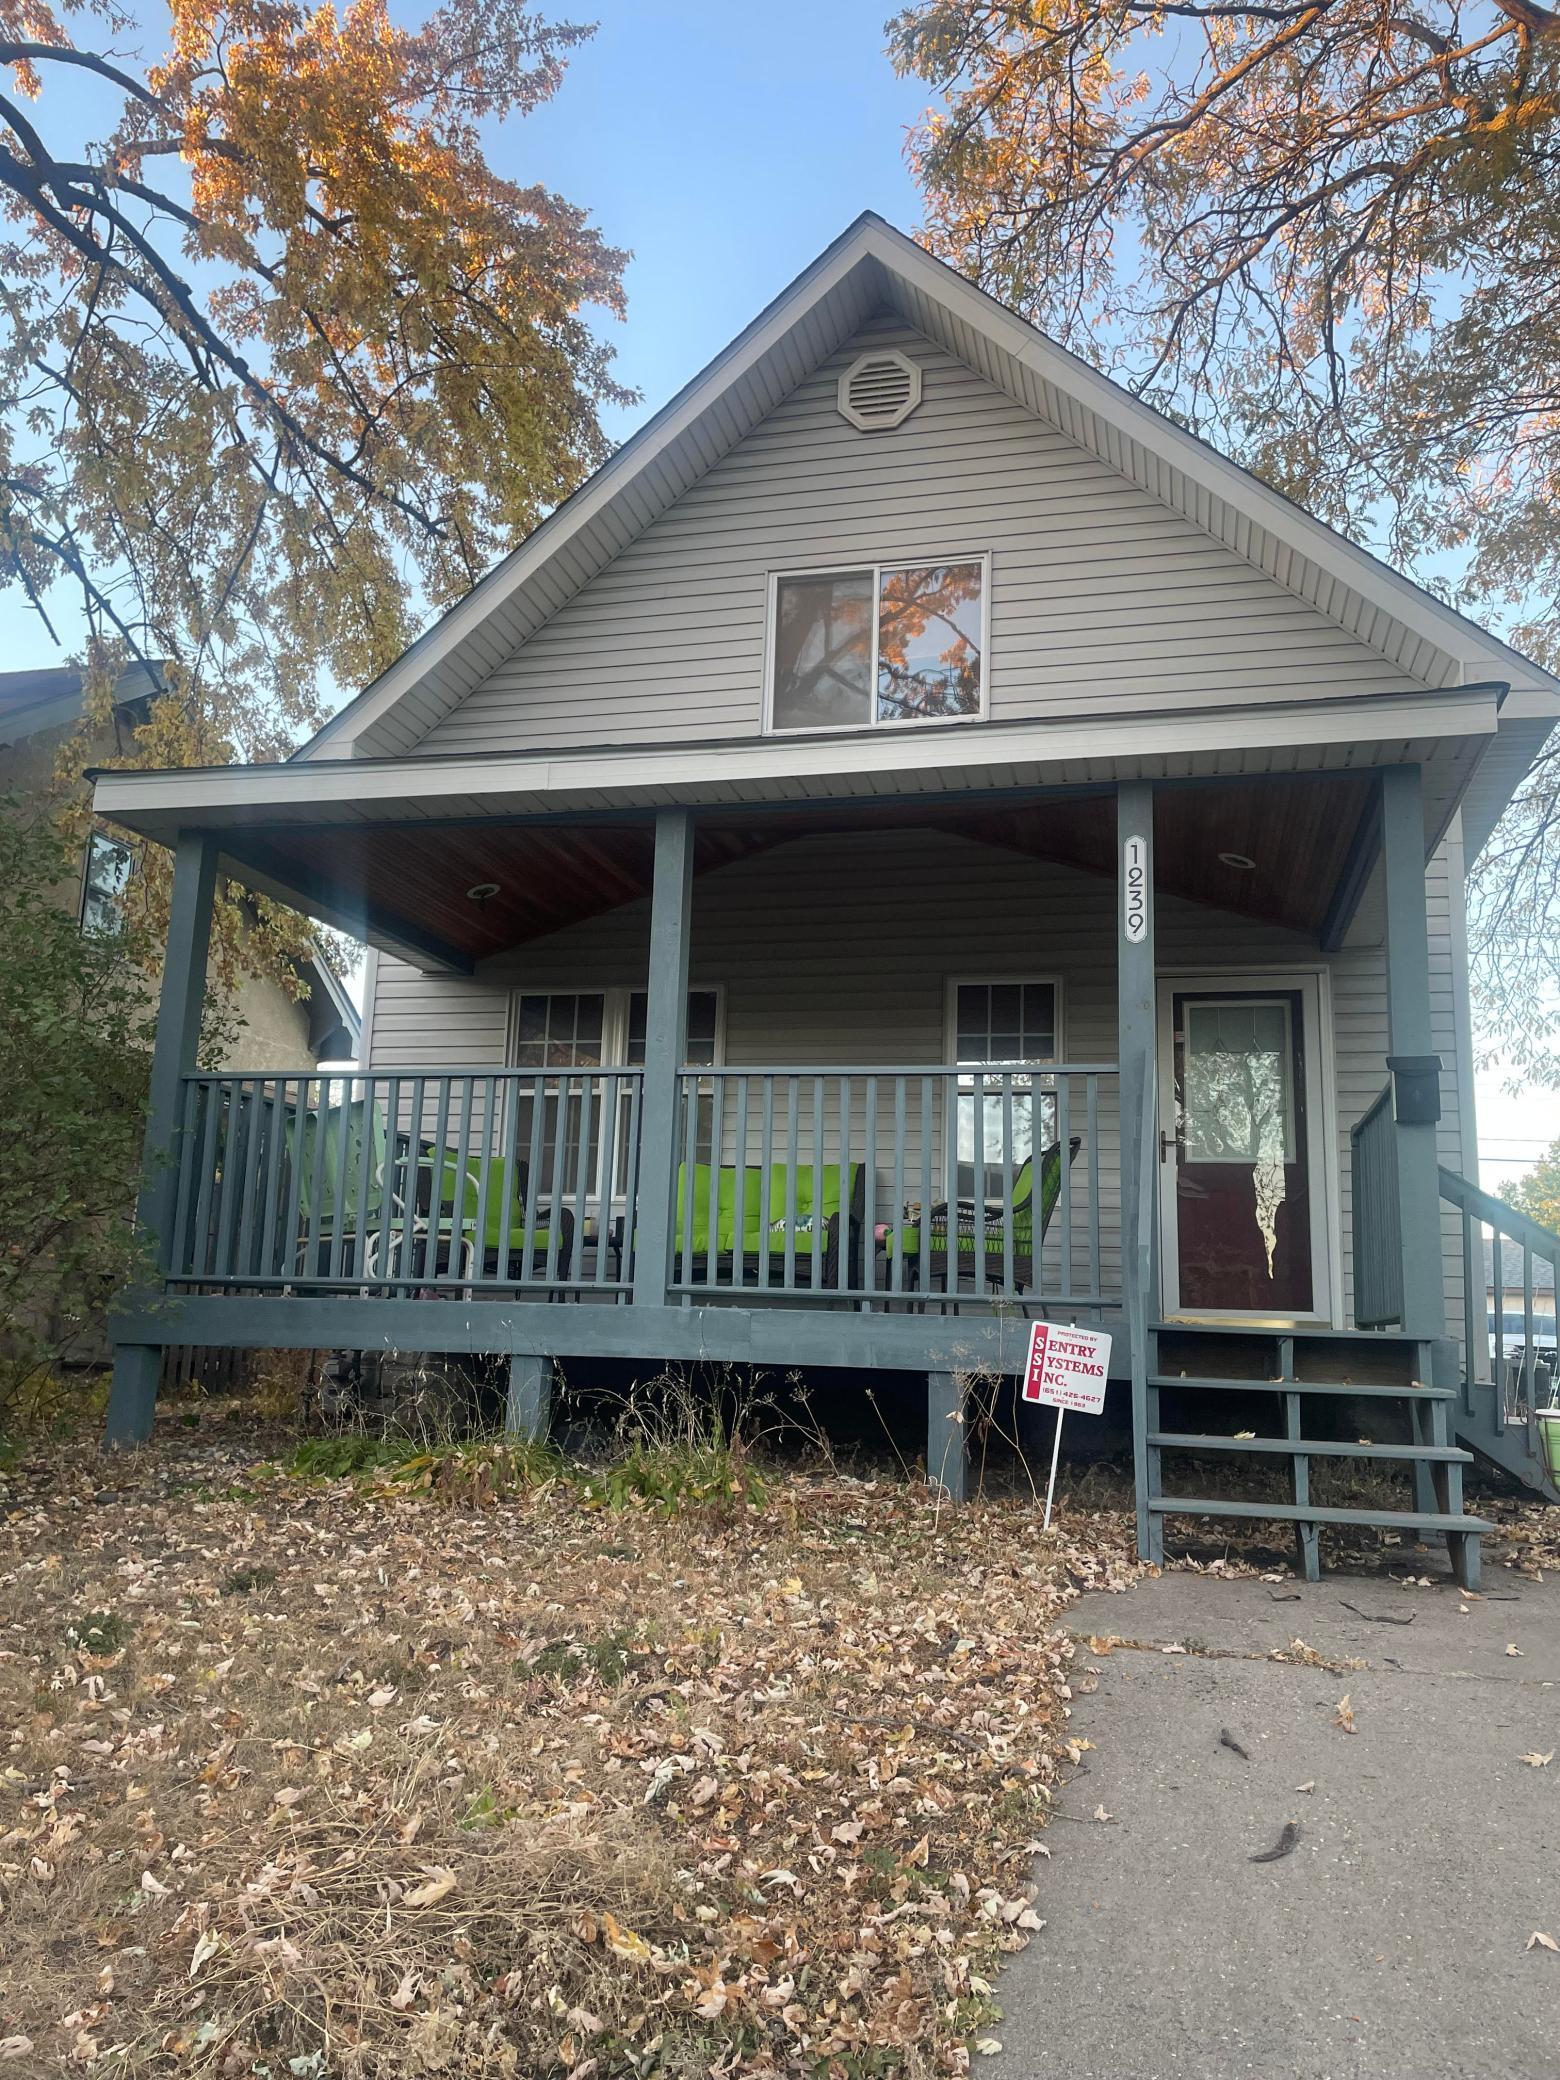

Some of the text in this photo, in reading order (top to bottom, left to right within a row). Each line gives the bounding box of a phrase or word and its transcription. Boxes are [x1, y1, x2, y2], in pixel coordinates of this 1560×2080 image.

[1127, 844, 1144, 934] 1239
[1057, 1331, 1089, 1341] PROTECTED
[1043, 1387, 1062, 1396] (651)
